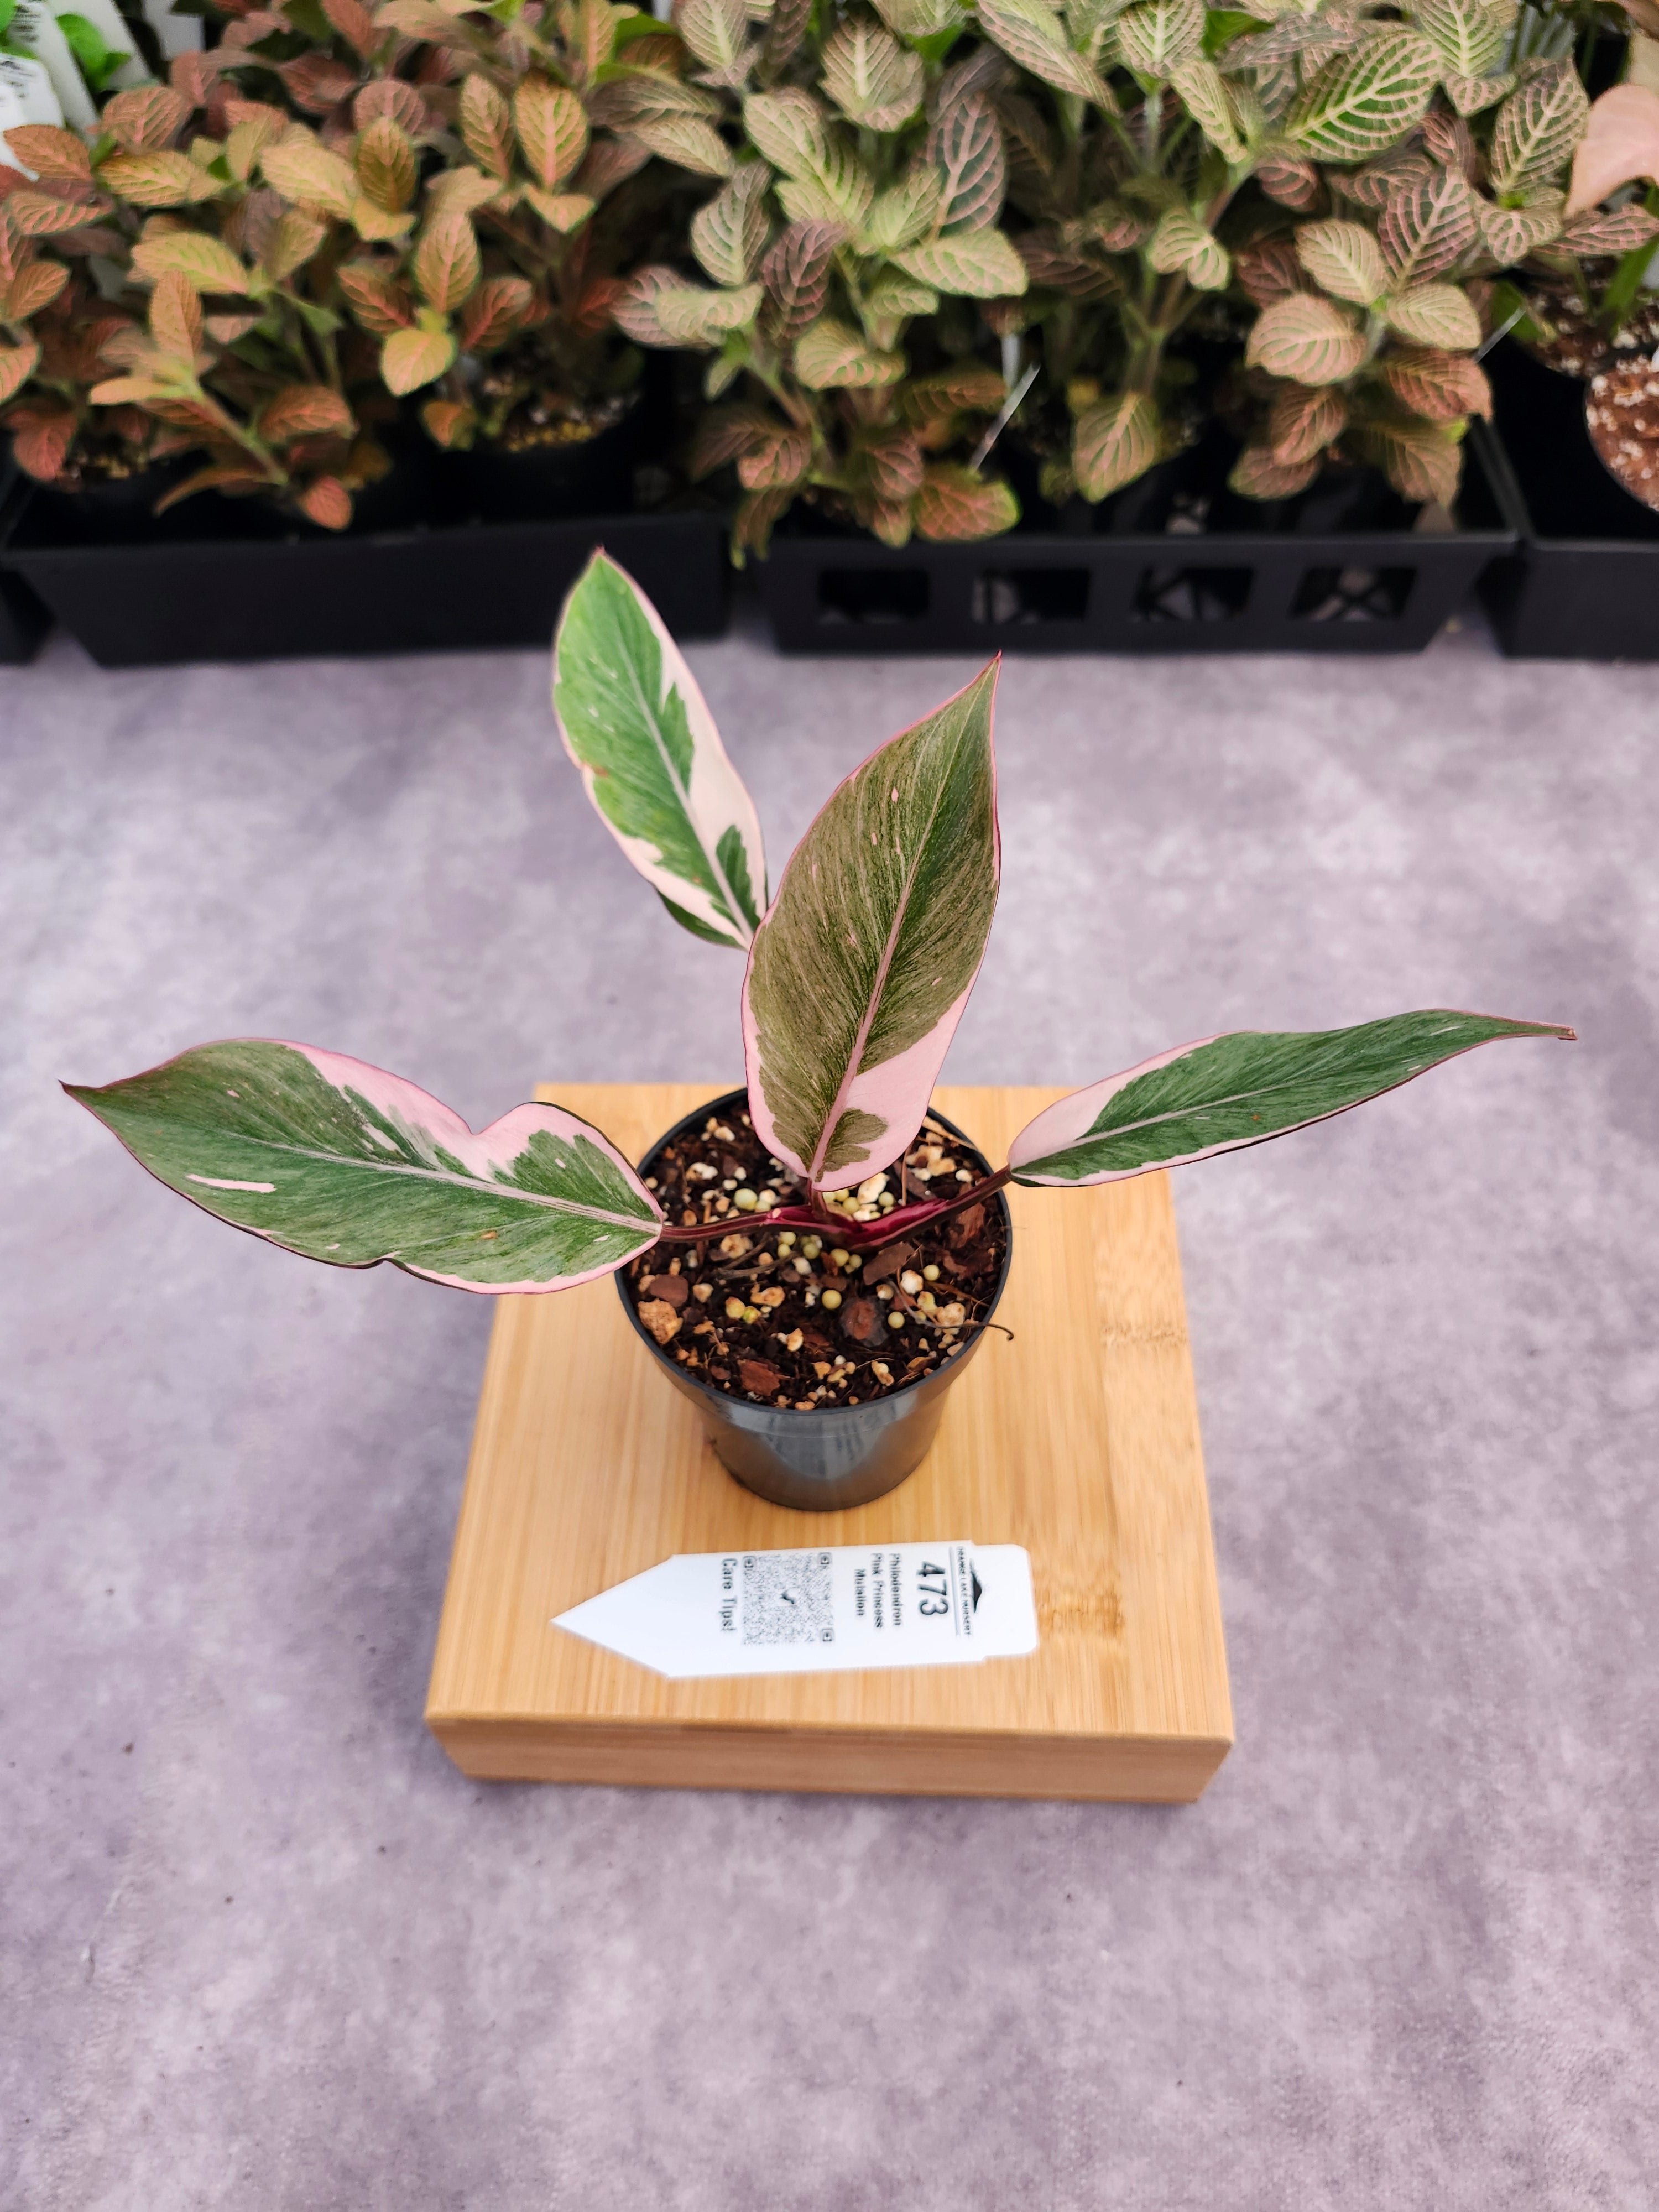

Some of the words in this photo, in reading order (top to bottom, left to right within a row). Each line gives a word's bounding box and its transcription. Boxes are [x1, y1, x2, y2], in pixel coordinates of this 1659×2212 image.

[722, 1558, 737, 1589] Care
[871, 1553, 883, 1575] Pink
[854, 1569, 867, 1616] Mutation
[873, 1580, 884, 1628] Princess
[889, 1553, 902, 1626] Philodendron
[917, 1561, 948, 1615] 473
[959, 1577, 968, 1597] LAKE
[719, 1595, 737, 1631] Tips!
